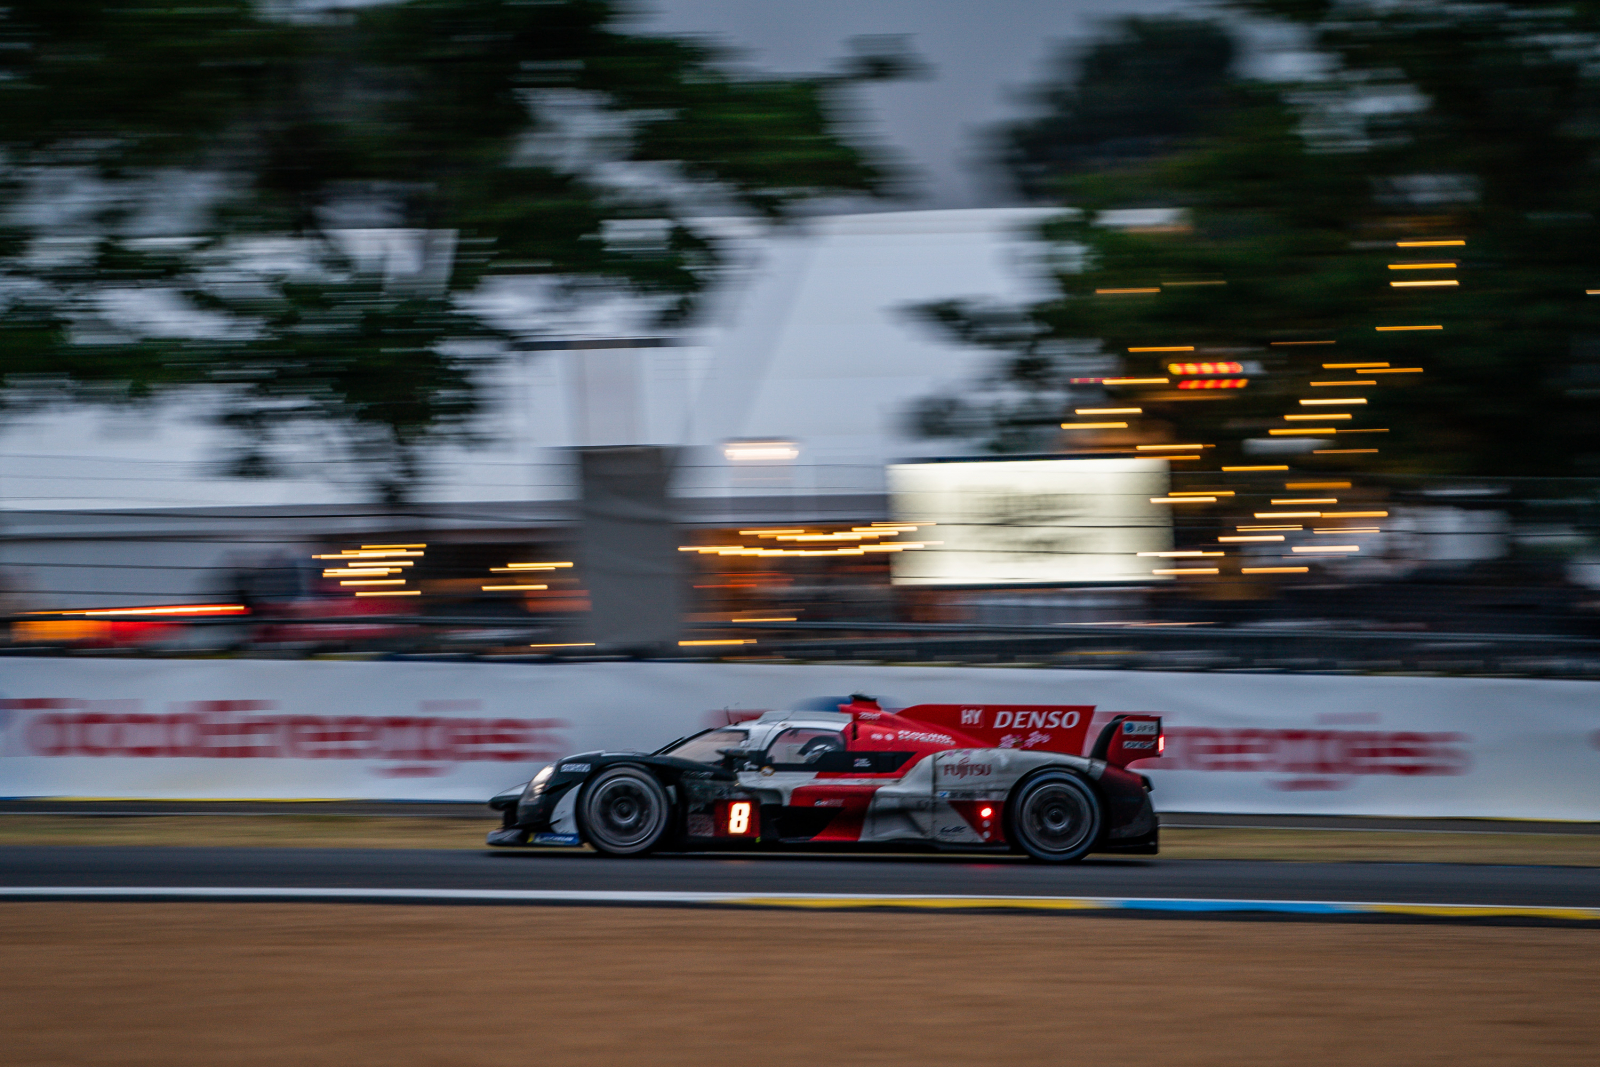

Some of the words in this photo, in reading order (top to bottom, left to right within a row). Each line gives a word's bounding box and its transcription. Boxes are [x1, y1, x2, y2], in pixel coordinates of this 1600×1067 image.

[961, 709, 983, 725] HY
[993, 711, 1081, 729] DENSO
[943, 761, 992, 779] FUJITSU
[728, 802, 751, 834] 8
